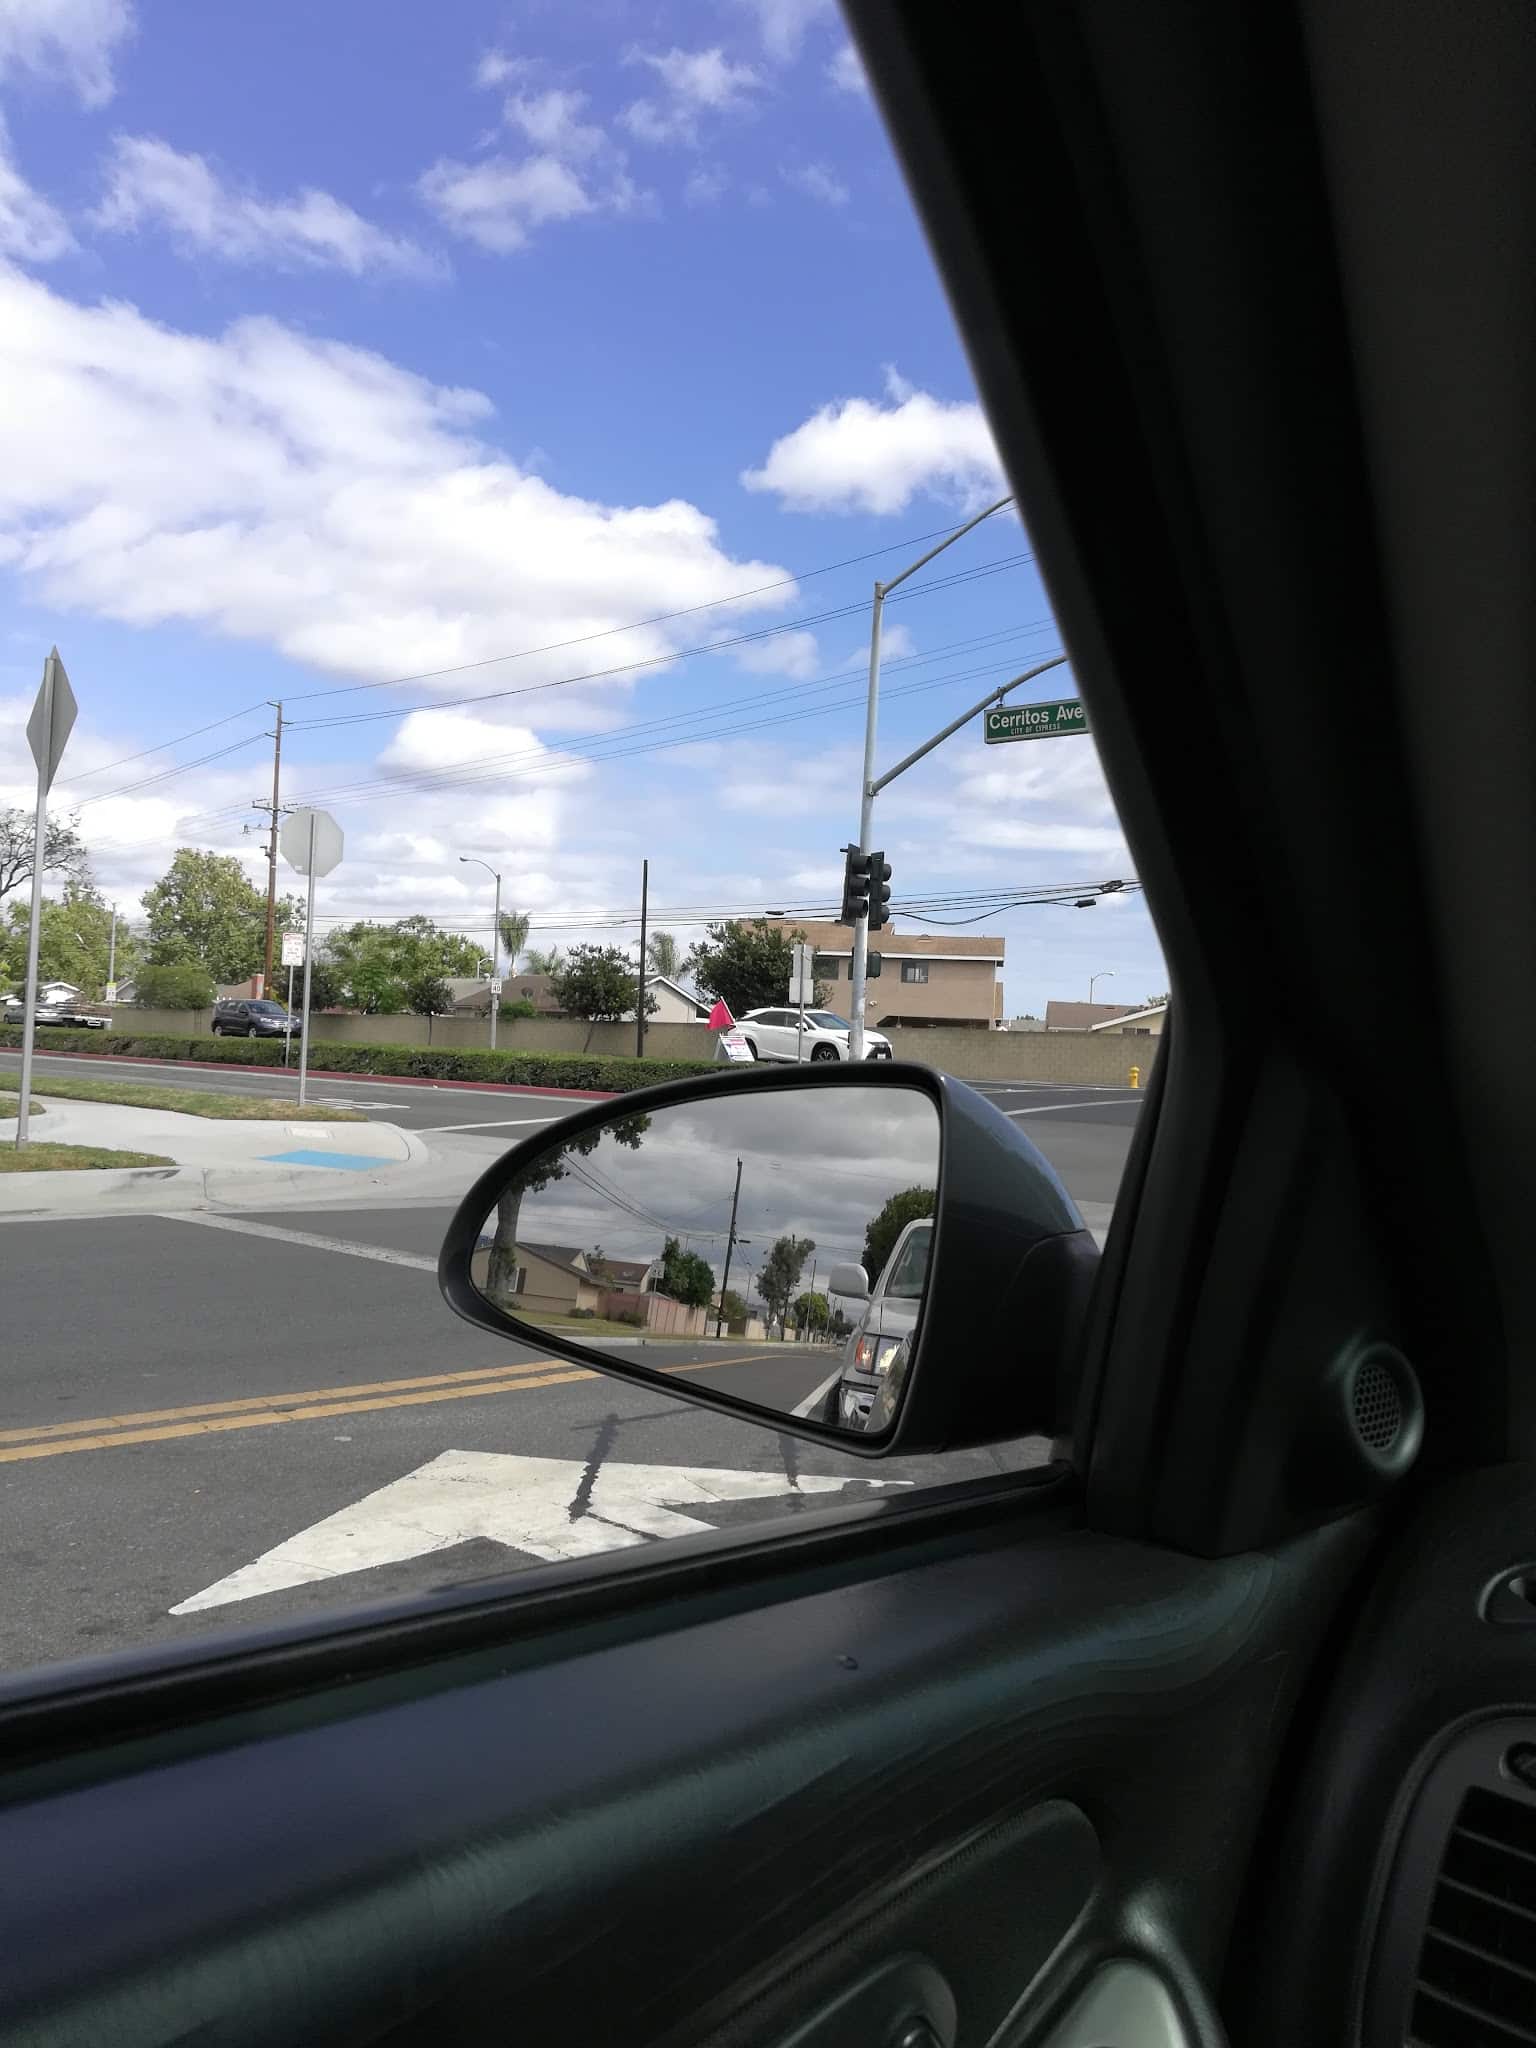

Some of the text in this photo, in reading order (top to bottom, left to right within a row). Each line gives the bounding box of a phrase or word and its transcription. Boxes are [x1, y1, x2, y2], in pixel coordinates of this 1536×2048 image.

[989, 705, 1084, 729] Cerritos Ave
[1010, 727, 1023, 736] CITY
[1025, 725, 1033, 734] OF
